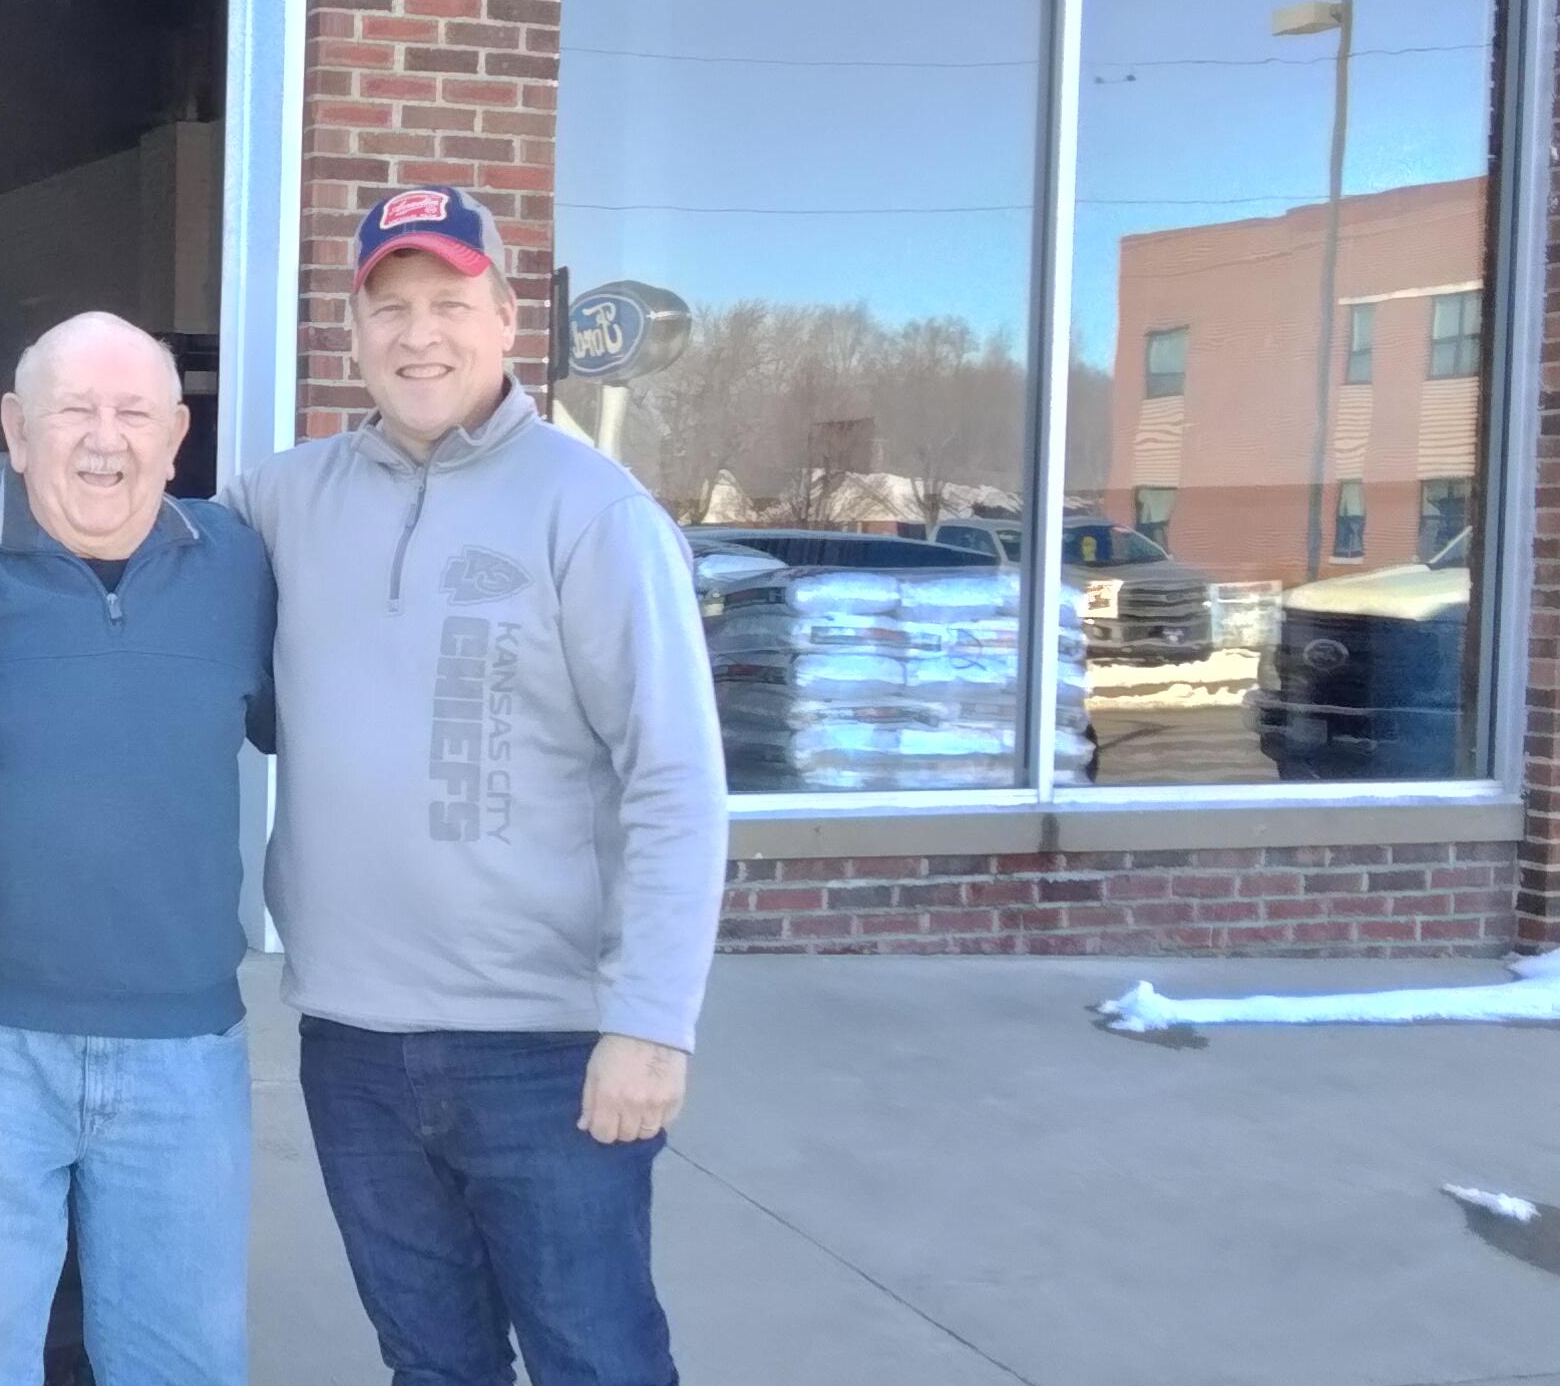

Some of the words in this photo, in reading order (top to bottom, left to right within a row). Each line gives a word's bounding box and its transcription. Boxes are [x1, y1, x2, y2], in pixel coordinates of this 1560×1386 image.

[428, 615, 490, 842] CHIEFS
[487, 621, 523, 762] KANSAS
[486, 769, 512, 846] CITY
